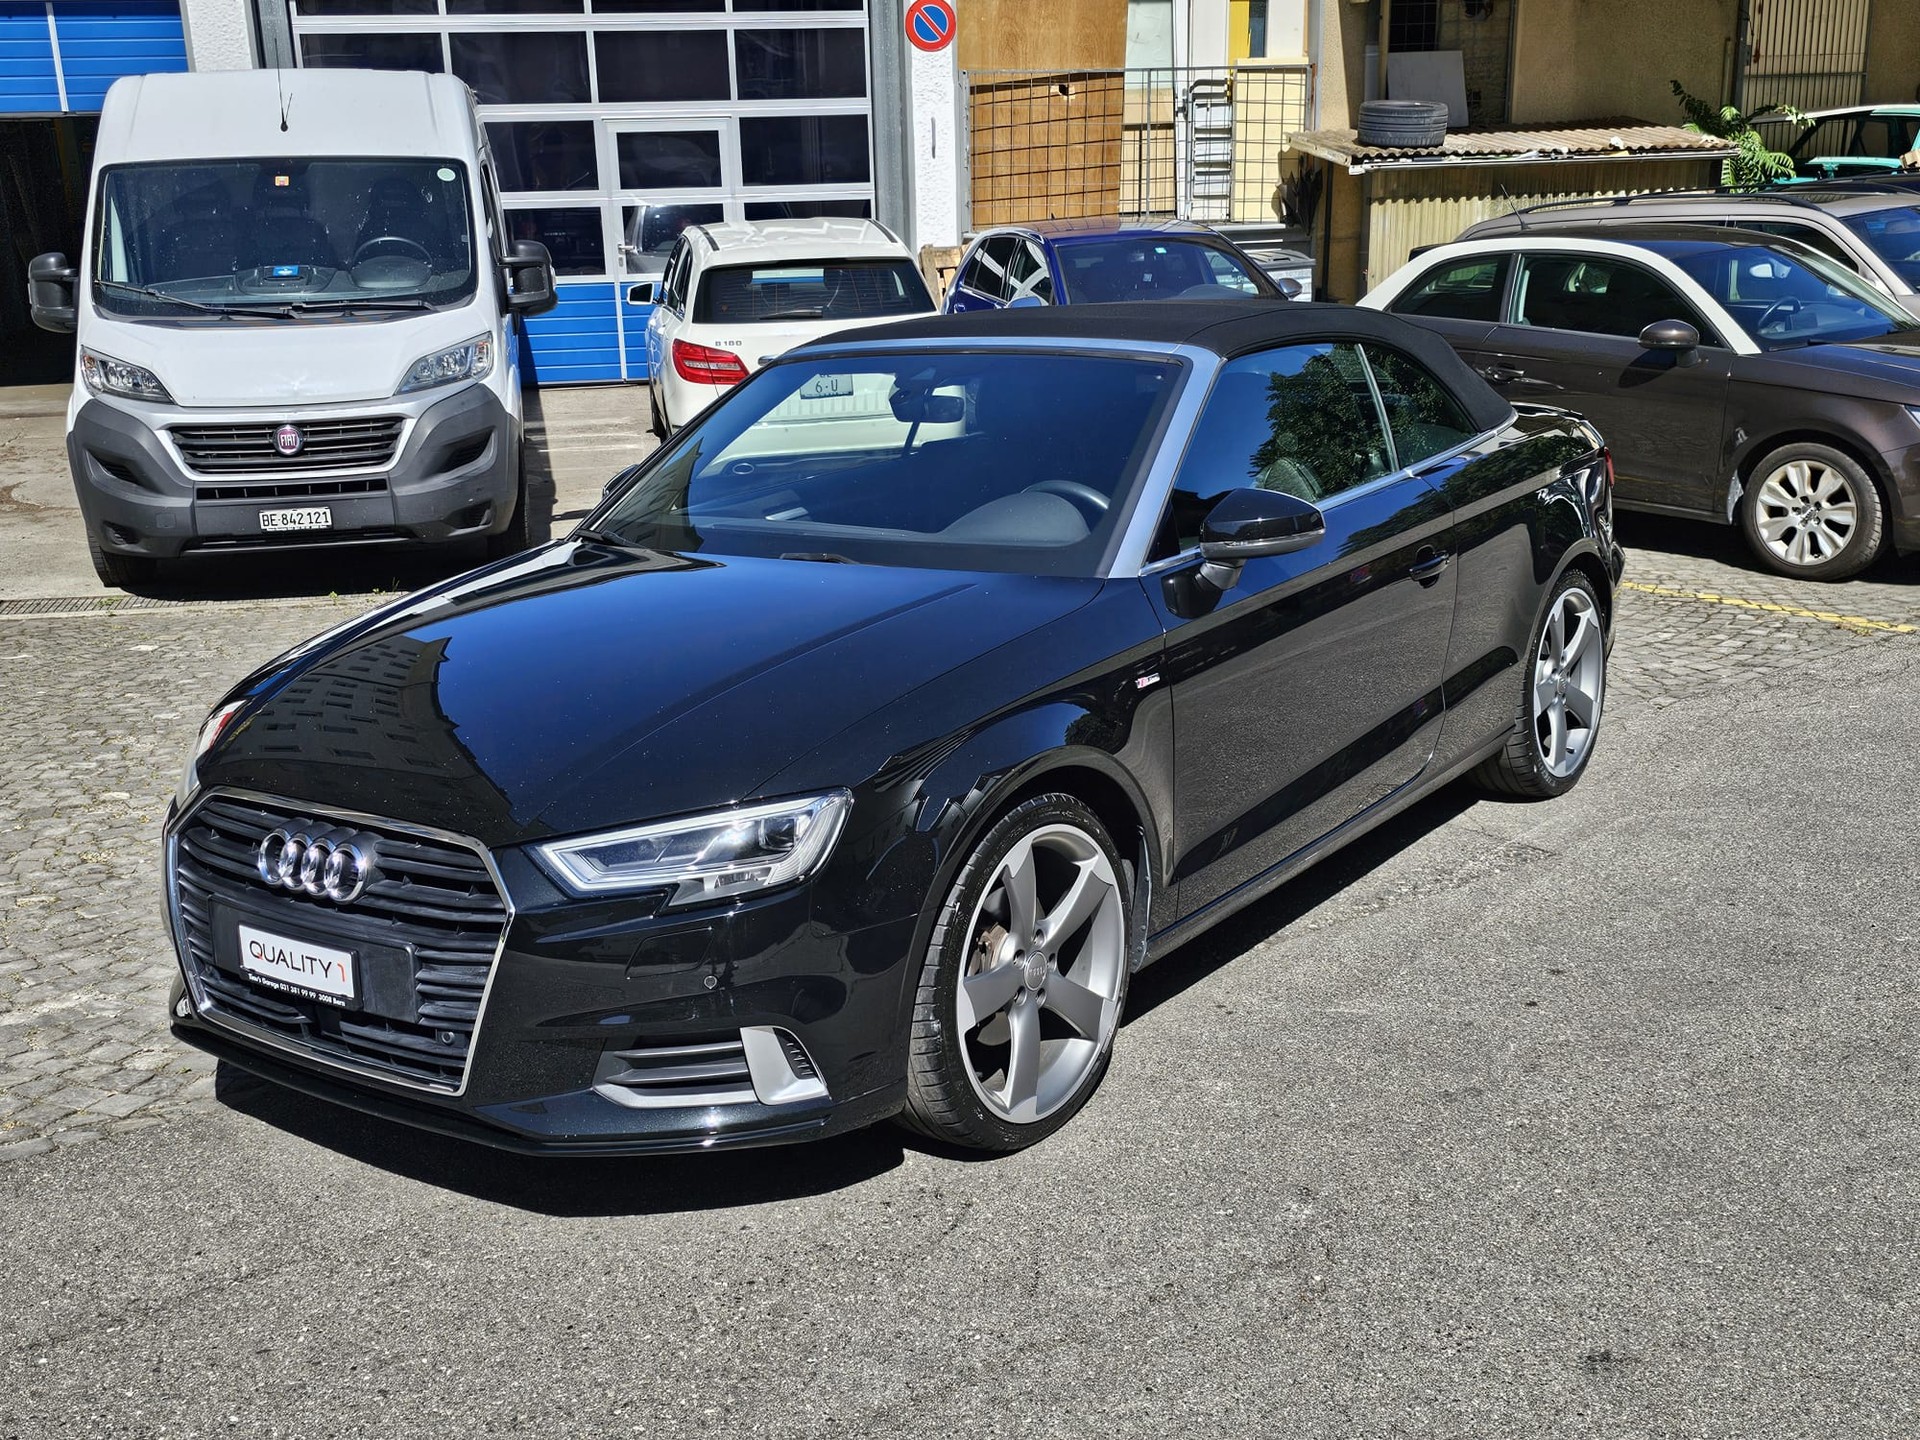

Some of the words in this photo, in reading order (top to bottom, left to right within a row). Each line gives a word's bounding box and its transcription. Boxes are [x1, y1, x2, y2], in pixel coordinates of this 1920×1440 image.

[280, 433, 296, 447] FIAT
[249, 940, 332, 978] QUALITY
[337, 963, 346, 982] 1
[262, 977, 279, 989] Garage
[301, 988, 308, 997] 99
[309, 991, 317, 999] 99
